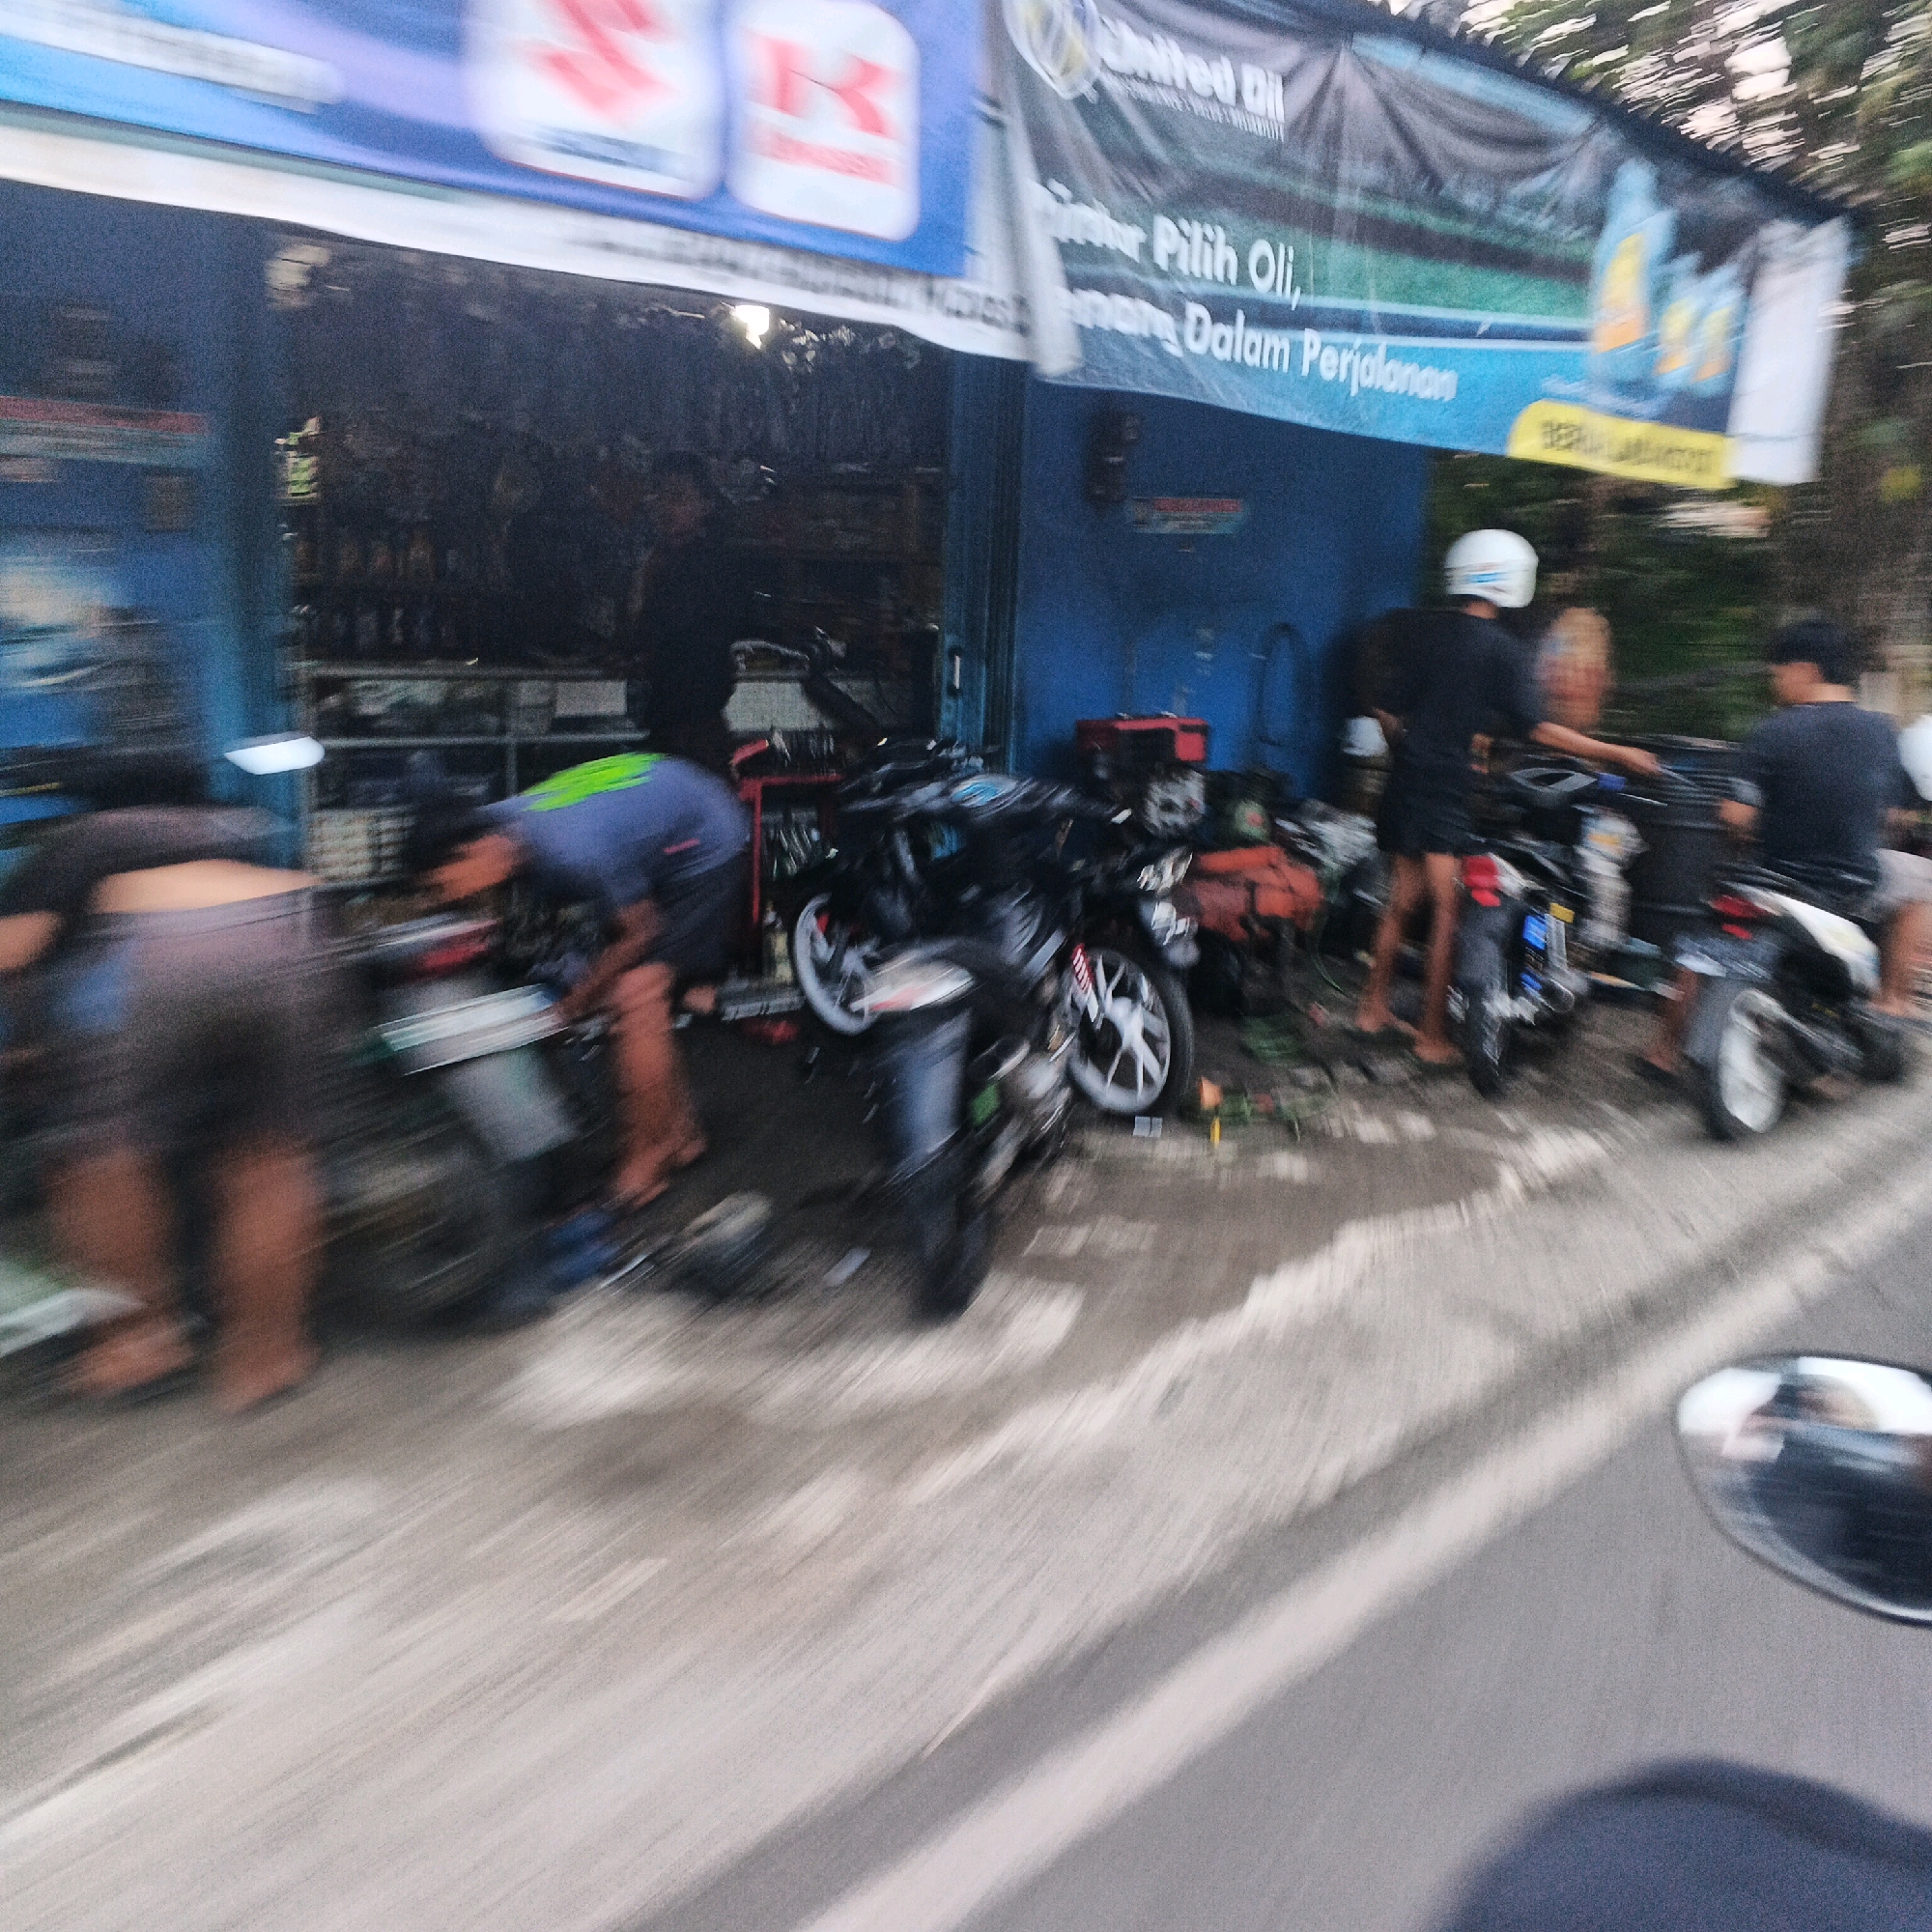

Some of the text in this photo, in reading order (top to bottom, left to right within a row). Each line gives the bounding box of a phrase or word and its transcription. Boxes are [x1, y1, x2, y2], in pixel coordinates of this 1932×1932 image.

[1153, 214, 1238, 286] Pilih
[1248, 239, 1301, 311] Oli,
[1053, 286, 1184, 358] enang
[1182, 300, 1291, 374] Dalam
[1300, 327, 1460, 402] Perjalanan
